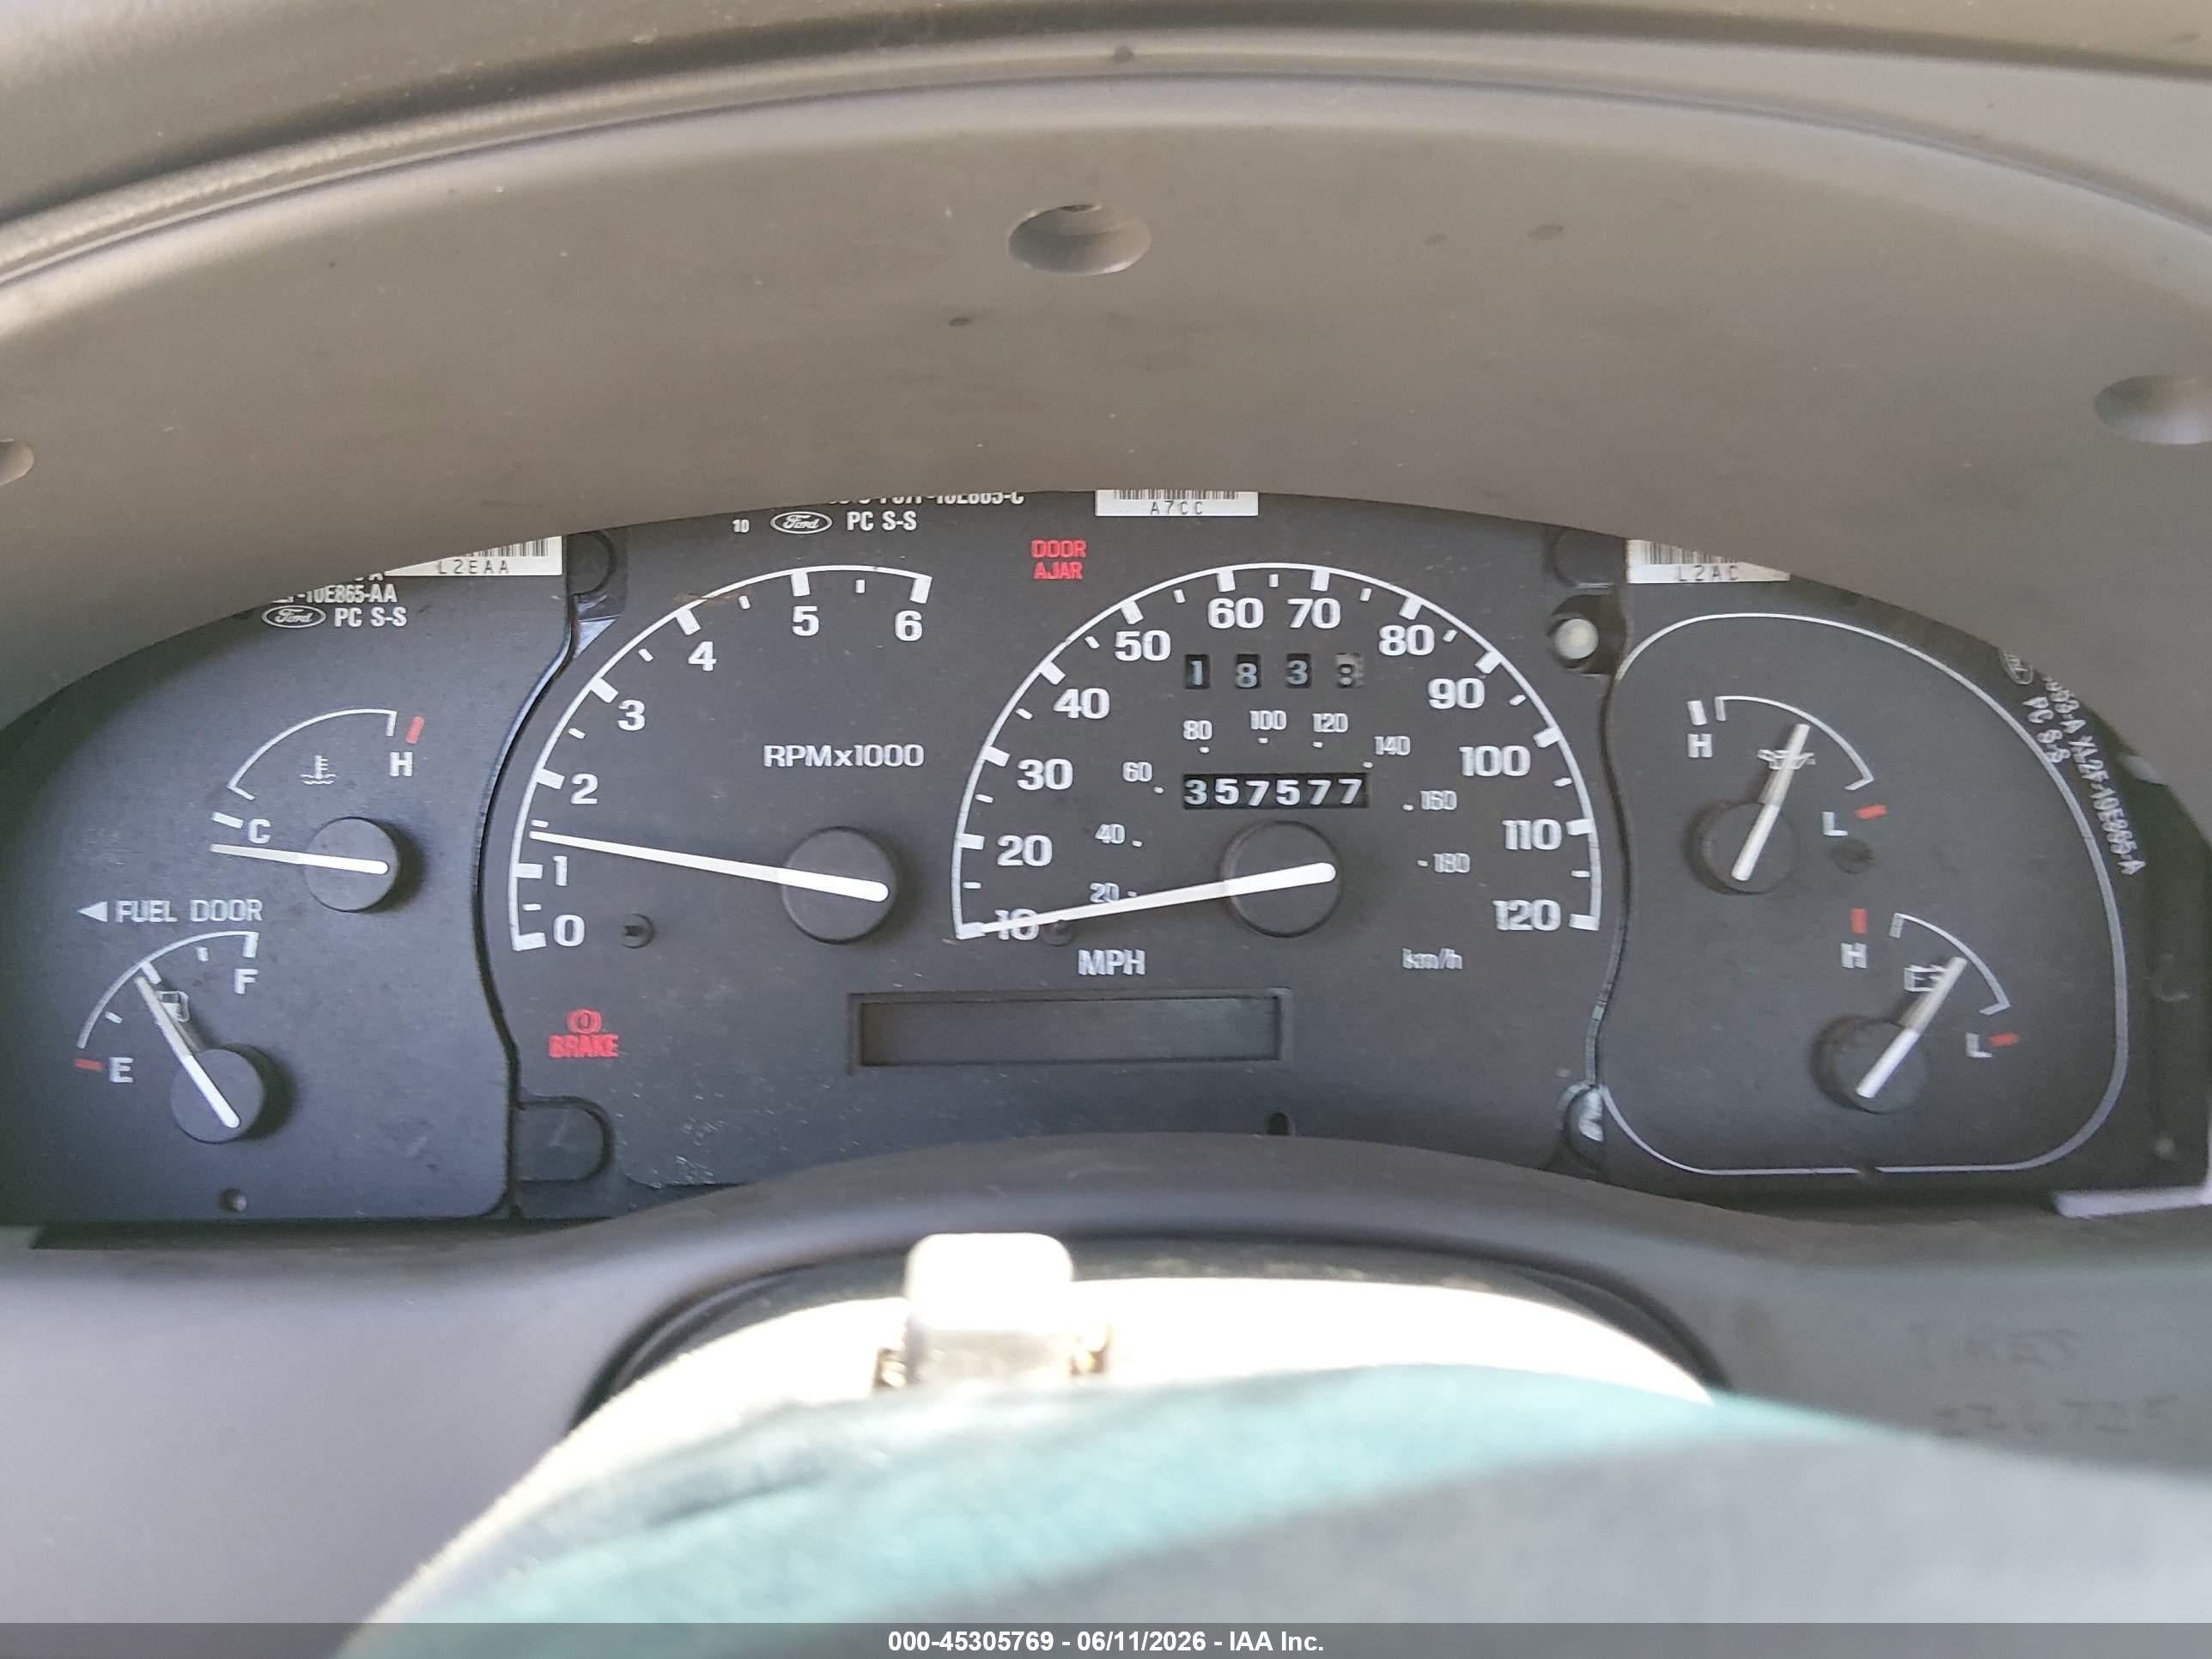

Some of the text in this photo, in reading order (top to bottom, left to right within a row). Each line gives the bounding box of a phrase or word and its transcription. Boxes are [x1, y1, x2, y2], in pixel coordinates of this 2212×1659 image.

[780, 511, 916, 531] Ford PC S-S
[1146, 500, 1206, 517] A7CC
[732, 520, 749, 532] 10
[1032, 540, 1085, 558] DOOR
[1036, 561, 1082, 579] AJAR
[274, 607, 406, 627] Ford PC S-S
[793, 606, 818, 635] 5
[896, 611, 922, 641] 6
[1208, 598, 1263, 629] 60
[1288, 599, 1340, 629] 70
[1115, 630, 1170, 660] 50
[1380, 625, 1434, 655] 80
[689, 641, 716, 671] 4
[1192, 661, 1202, 685] 1
[1237, 663, 1256, 687] 8
[1286, 660, 1307, 684] 3
[1054, 689, 1109, 719] 40
[1429, 677, 1485, 708] 90
[618, 699, 645, 730] 3
[1250, 710, 1286, 730] 100
[1313, 714, 1348, 732] 120
[1184, 720, 1212, 739] 80
[764, 744, 923, 767] RPMx1000
[1375, 736, 1410, 755] 140
[1688, 734, 1711, 757] H
[390, 752, 412, 776] H
[1123, 763, 1152, 781] 60
[1460, 745, 1530, 776] 100
[1018, 759, 1073, 790] 30
[572, 774, 598, 804] 2
[1185, 779, 1362, 805] 357577
[1421, 791, 1456, 810] 160
[248, 819, 270, 843] C
[1096, 824, 1125, 843] 40
[1503, 819, 1561, 849] 110
[1823, 812, 1848, 836] L
[998, 836, 1052, 866] 20
[1434, 854, 1470, 872] 180
[554, 856, 567, 885] 1
[1090, 882, 1120, 902] 20
[117, 899, 262, 922] FUEL DOOR
[1493, 900, 1560, 931] 120
[555, 915, 584, 946] 0
[994, 908, 1039, 940] 10
[1079, 950, 1145, 975] MPH
[1403, 949, 1462, 969] km/h
[1841, 943, 1866, 968] H
[235, 969, 258, 994] F
[550, 1033, 620, 1058] BRAKE
[1966, 1034, 1991, 1058] L
[110, 1057, 133, 1082] E
